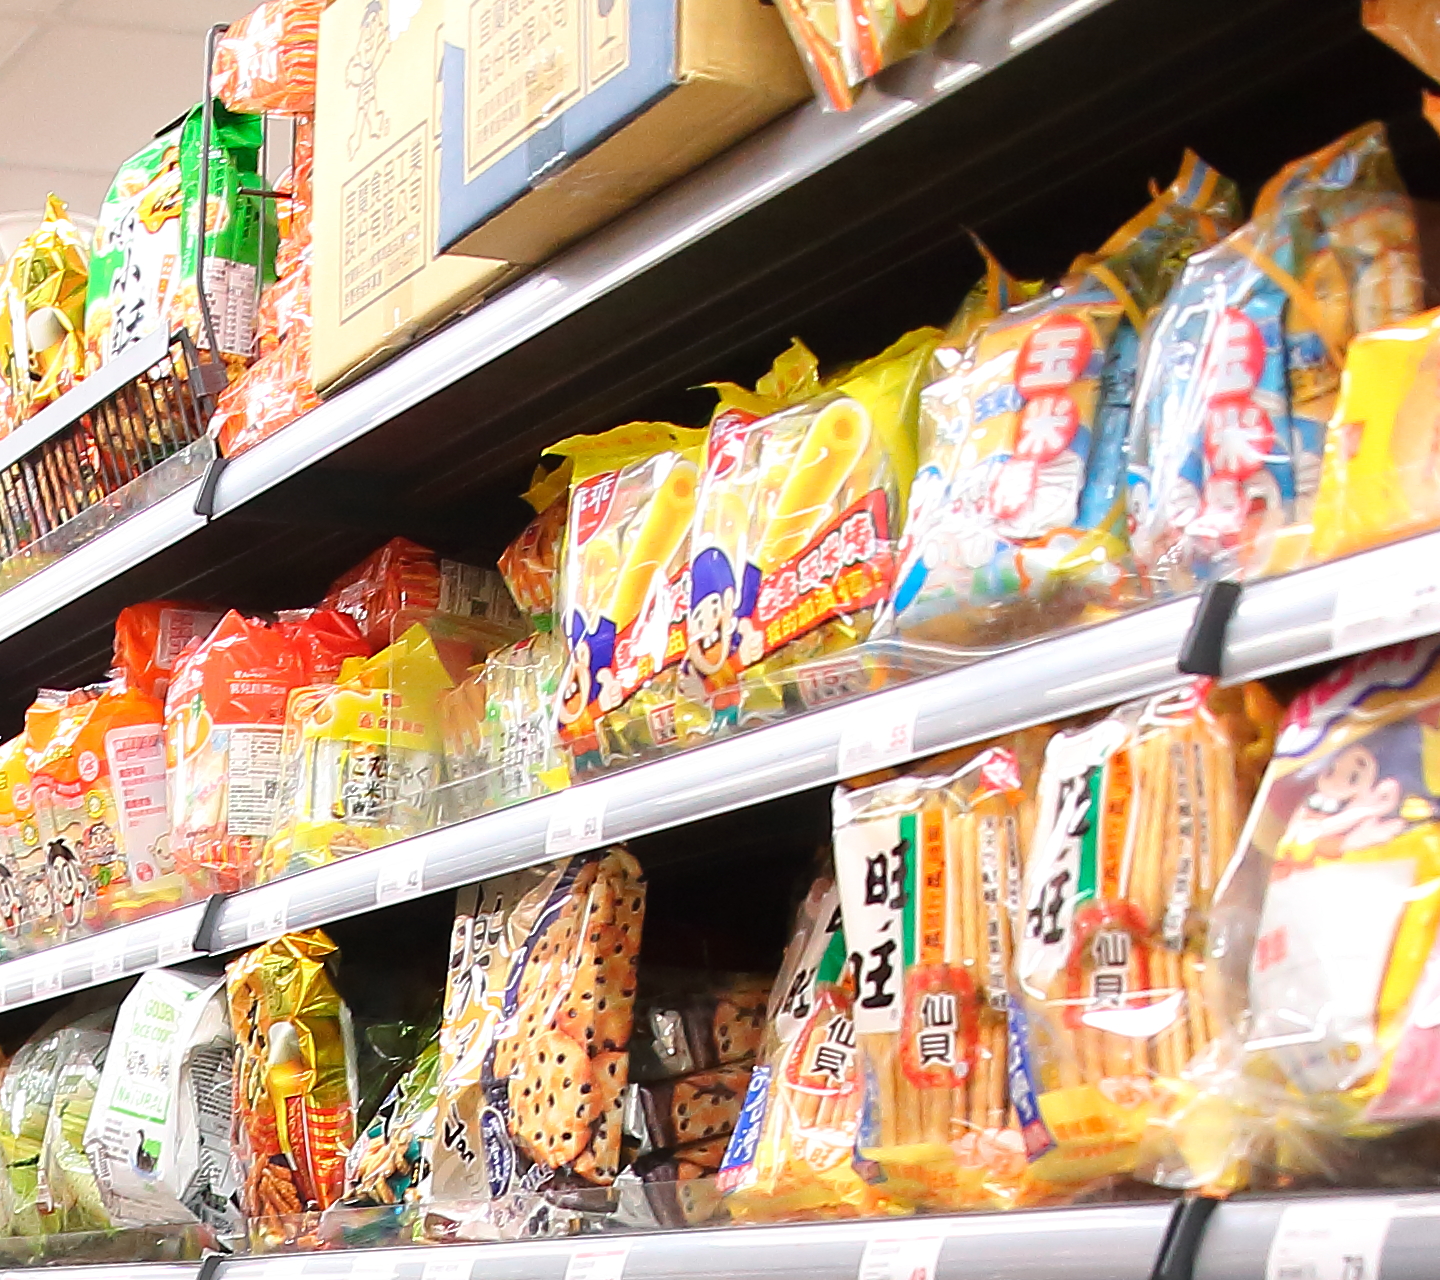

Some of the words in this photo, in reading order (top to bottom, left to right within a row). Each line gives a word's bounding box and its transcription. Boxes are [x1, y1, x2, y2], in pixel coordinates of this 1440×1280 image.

[850, 838, 910, 1010] 旺旺
[1094, 929, 1128, 1009] 仙貝
[810, 1016, 857, 1082] 仙貝
[919, 994, 960, 1066] 仙貝
